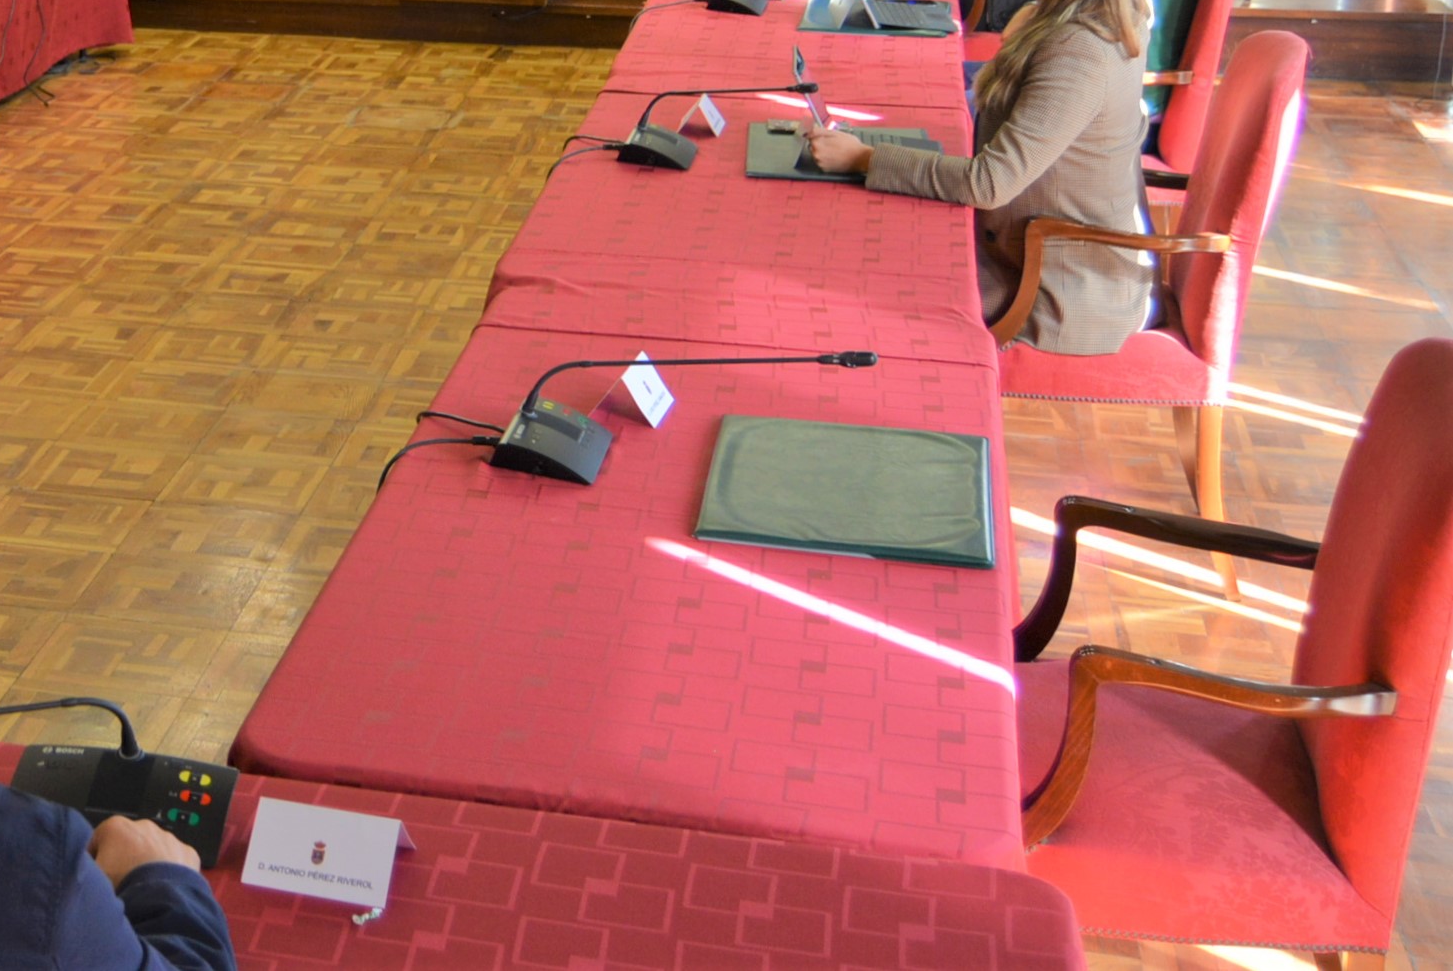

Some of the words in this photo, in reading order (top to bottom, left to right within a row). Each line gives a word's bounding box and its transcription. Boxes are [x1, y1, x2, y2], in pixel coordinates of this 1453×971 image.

[55, 746, 85, 755] BOSCH
[268, 864, 306, 878] ANTONIO
[307, 869, 336, 883] PÉREZ
[336, 877, 373, 890] RIVEROL
